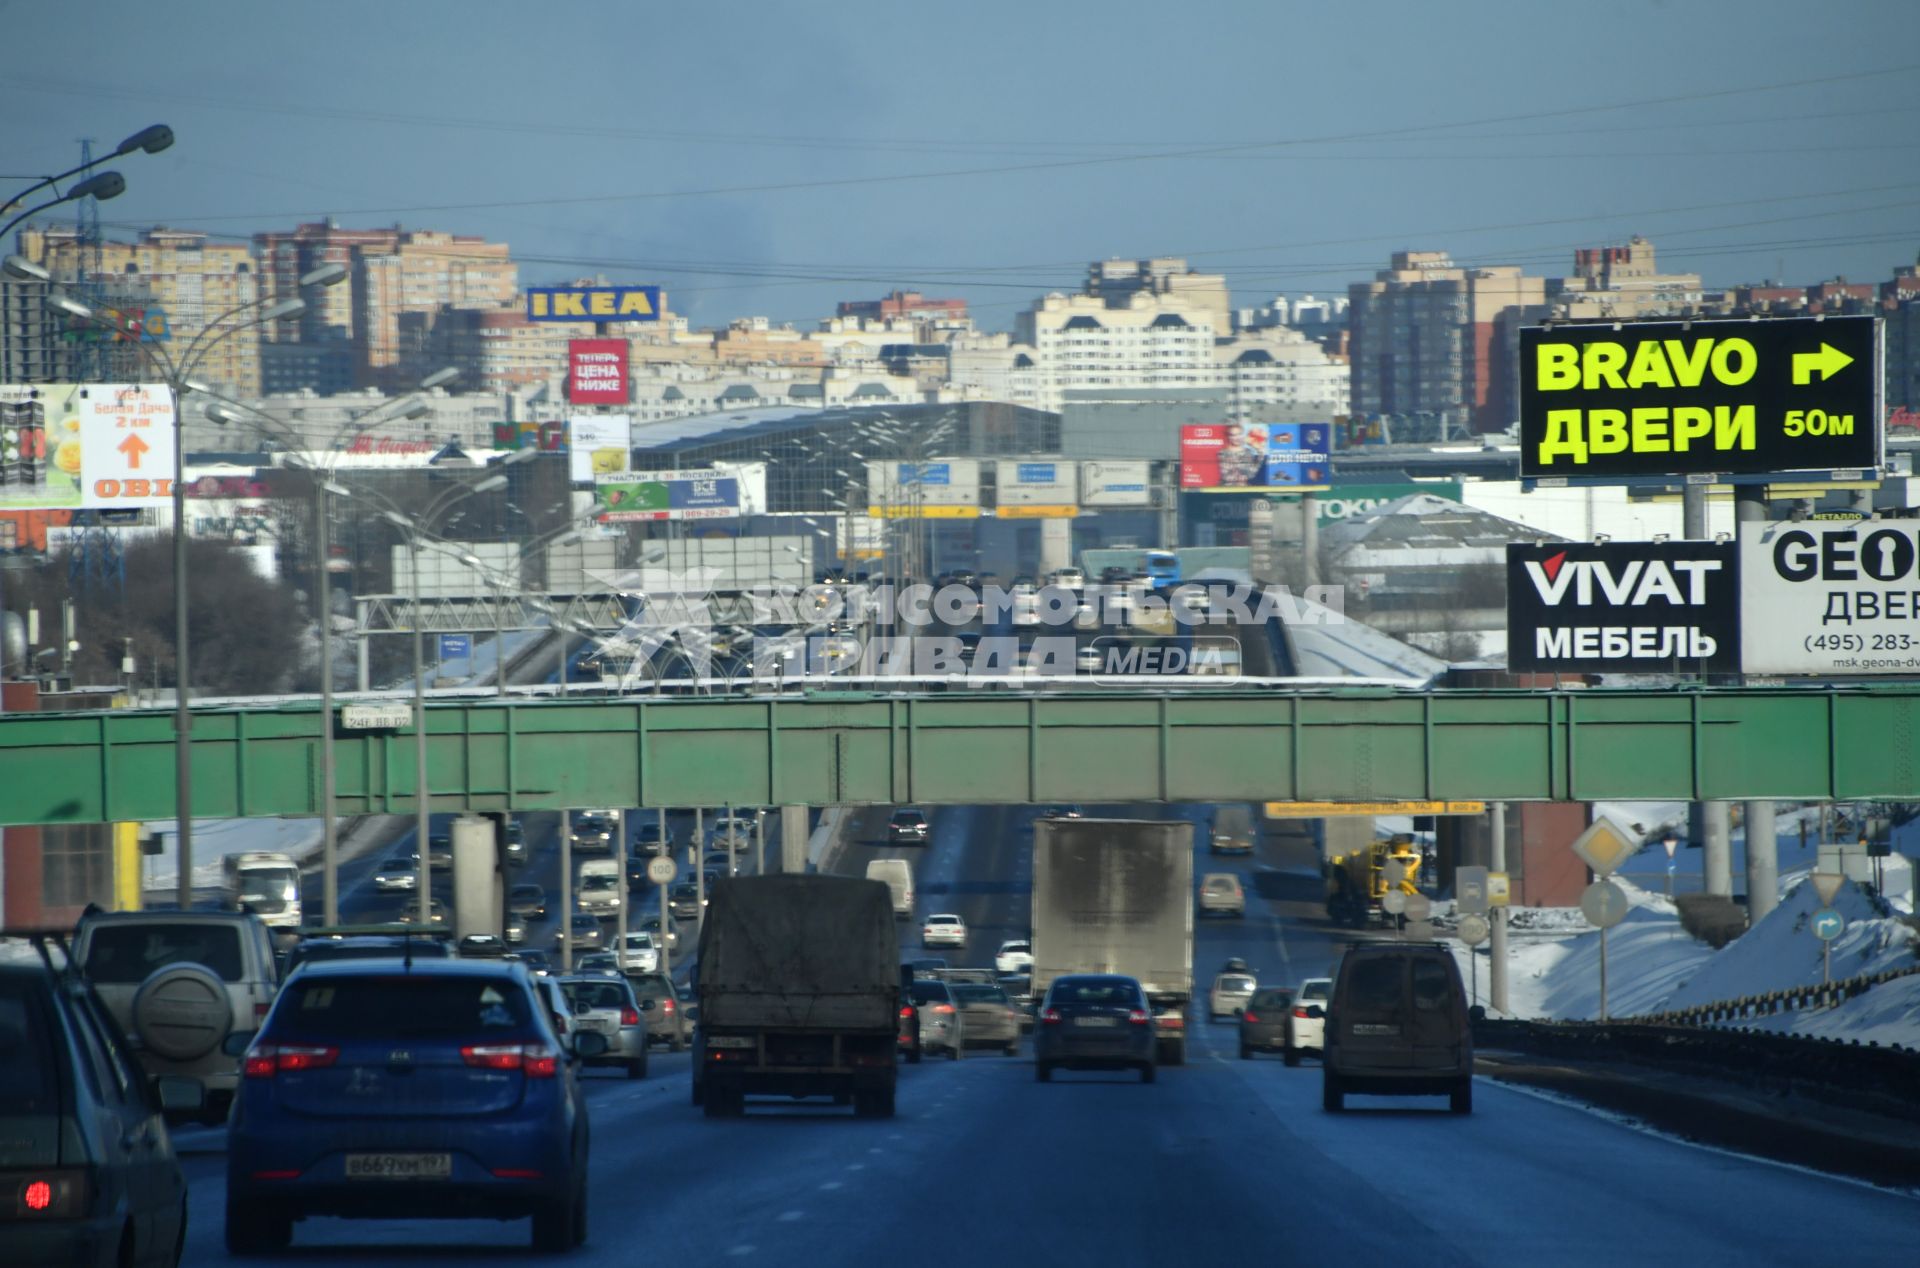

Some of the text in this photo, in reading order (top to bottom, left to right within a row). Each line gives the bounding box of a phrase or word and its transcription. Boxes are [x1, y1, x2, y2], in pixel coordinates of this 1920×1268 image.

[533, 292, 653, 316] IKEA
[576, 353, 619, 362] ТЕПЕРЬ
[1537, 337, 1758, 391] BRAVO
[576, 365, 619, 379] ЦЕНА
[576, 380, 620, 391] НИЖЕ
[116, 417, 125, 427] 2
[1539, 405, 1756, 464] ДВЕРИ
[94, 479, 173, 498] OBI
[1773, 529, 1920, 582] GEO
[1525, 558, 1722, 606] VIVAT
[1536, 626, 1717, 658] МЕБЕЛЬ
[1804, 634, 1864, 652] (495)
